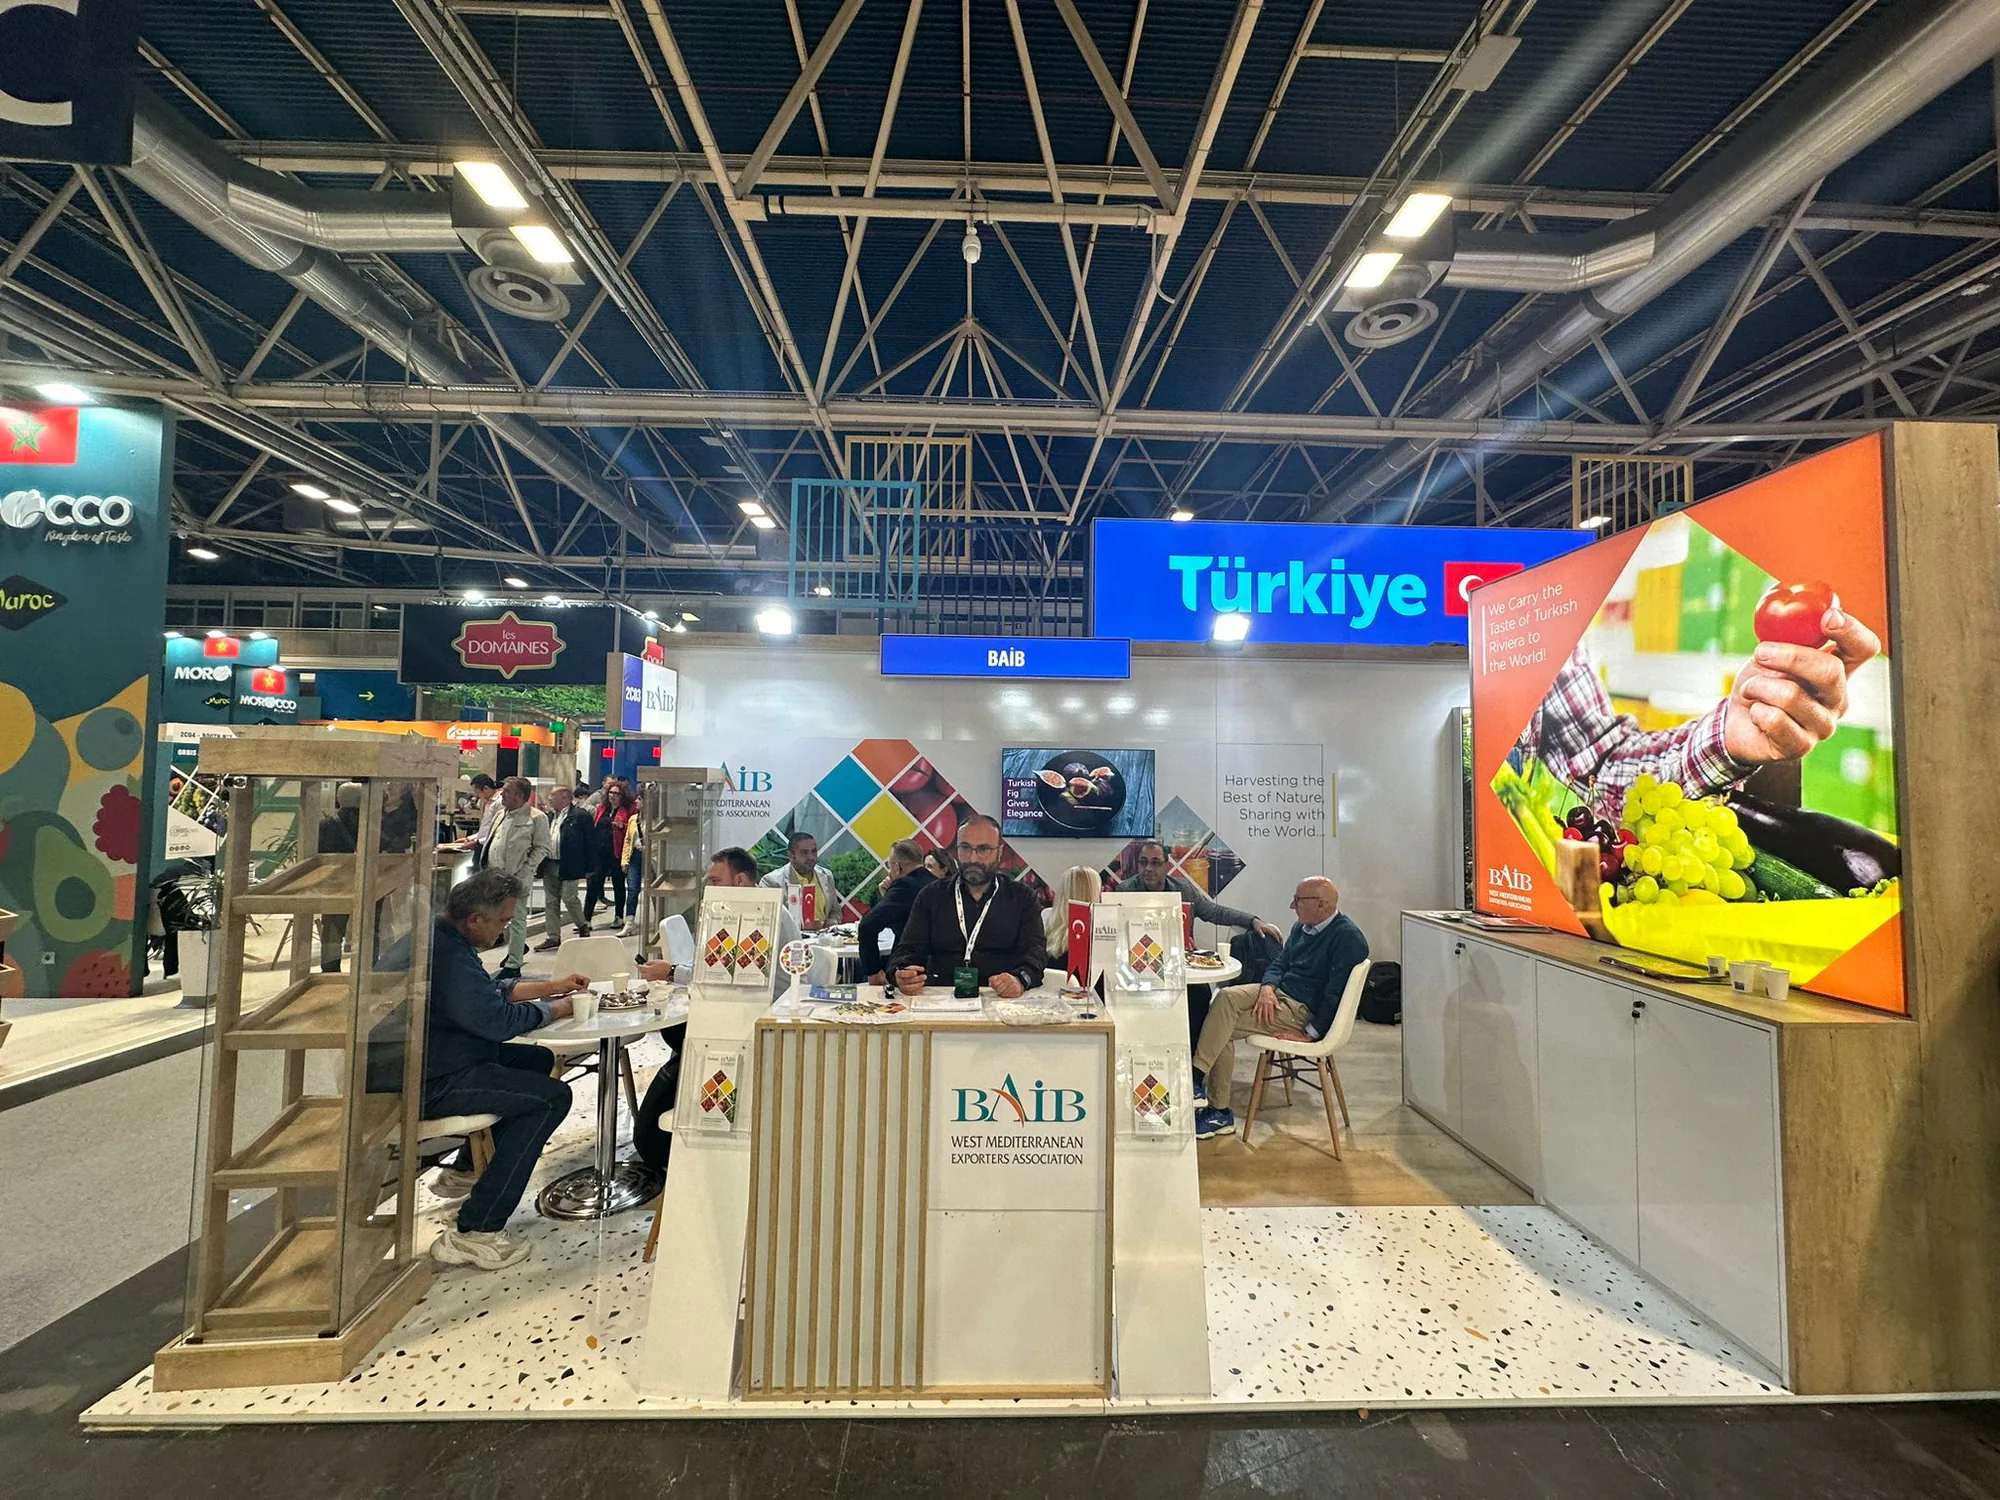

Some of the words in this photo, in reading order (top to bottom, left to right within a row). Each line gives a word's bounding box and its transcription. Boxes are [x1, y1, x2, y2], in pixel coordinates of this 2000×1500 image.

[44, 530, 90, 546] Kingdom
[91, 531, 104, 545] of
[104, 530, 132, 543] Taste
[1168, 554, 1427, 630] Türkiye
[1488, 602, 1505, 617] We
[1508, 592, 1539, 611] Carry
[1542, 584, 1563, 599] the
[1489, 618, 1516, 635] Taste
[1518, 611, 1530, 627] of
[1533, 598, 1578, 622] Turkish
[502, 629, 516, 640] les
[468, 640, 549, 655] DOMAINES
[1489, 633, 1524, 654] Riviera
[1528, 632, 1540, 644] to
[987, 646, 1026, 667] BAİB
[1489, 659, 1506, 673] the
[1509, 648, 1547, 668] World!
[1007, 779, 1037, 787] Turkish
[1225, 774, 1298, 788] Harvesting
[1302, 774, 1325, 786] the
[1007, 789, 1019, 799] Fig
[1223, 791, 1253, 803] Best
[1257, 791, 1271, 803] of
[1006, 799, 1030, 807] Gives
[725, 810, 770, 818] ASSOCIATION
[1006, 809, 1044, 819] Elegance
[1239, 808, 1291, 822] Sharing
[1296, 808, 1325, 820] with
[1248, 825, 1270, 837] the
[950, 1073, 1087, 1128] BAİB
[951, 1135, 983, 1148] WEST
[985, 1135, 1084, 1149] MEDITERRANEAN
[951, 1153, 1010, 1165] EXPORTERS
[1012, 1153, 1083, 1165] ASSOCIATION
